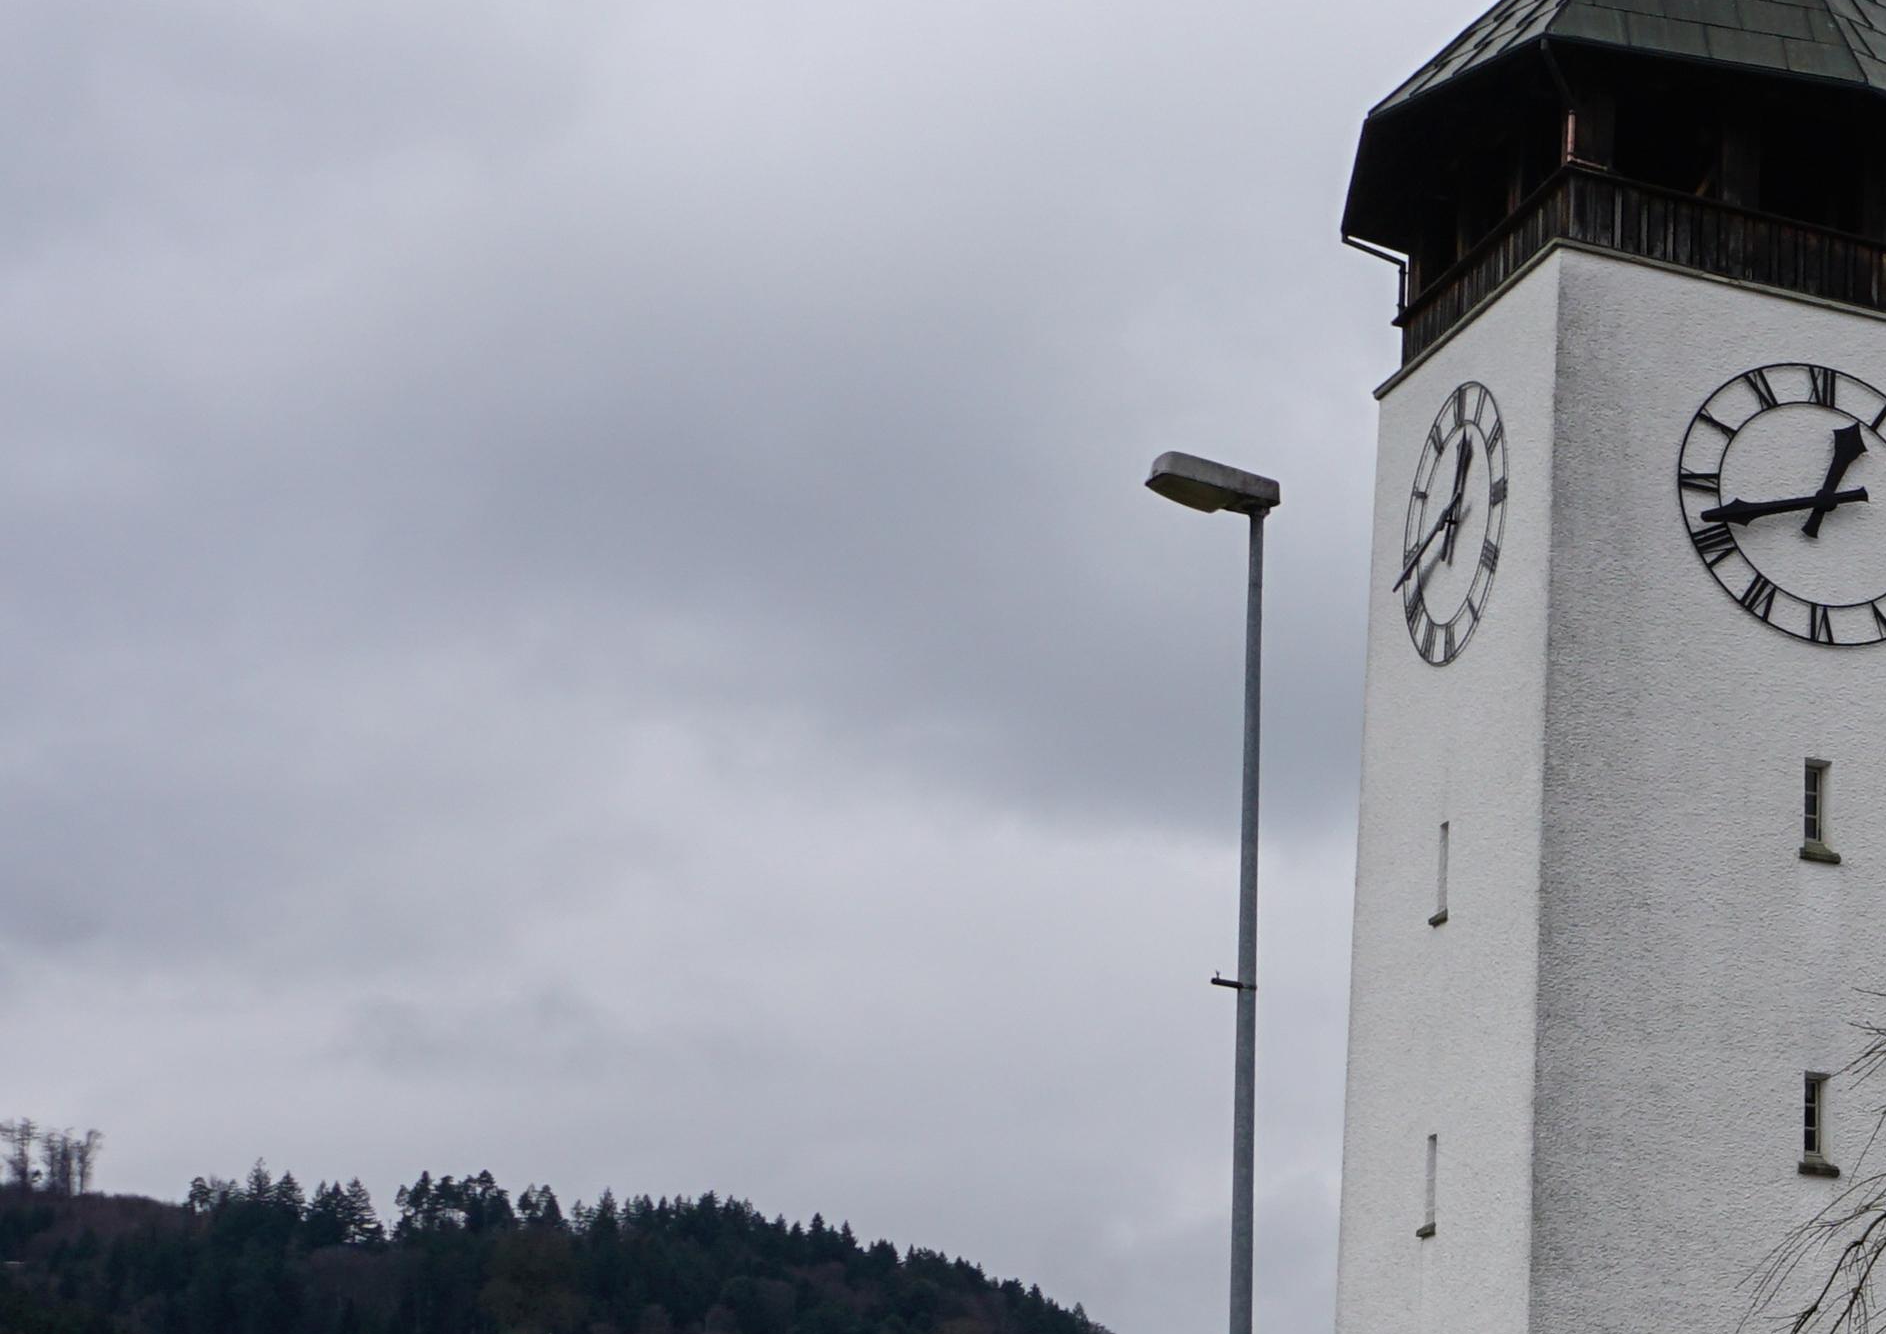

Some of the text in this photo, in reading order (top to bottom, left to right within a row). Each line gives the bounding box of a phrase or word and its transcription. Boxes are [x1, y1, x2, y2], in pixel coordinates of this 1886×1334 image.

[1808, 367, 1836, 408] XII
[1740, 574, 1777, 621] VII
[1810, 603, 1834, 643] VI
